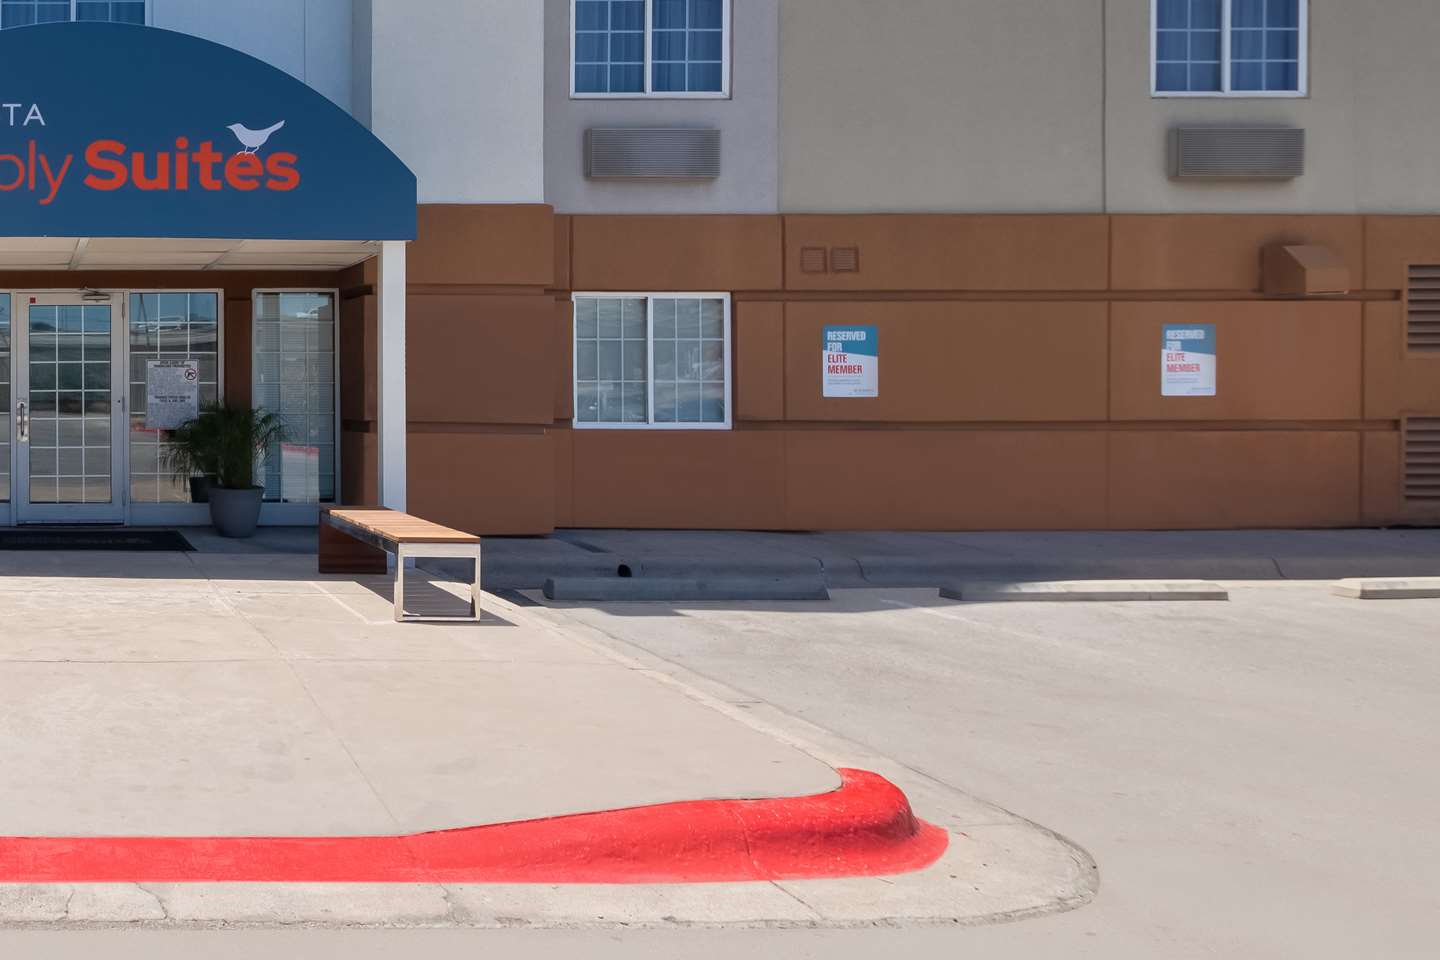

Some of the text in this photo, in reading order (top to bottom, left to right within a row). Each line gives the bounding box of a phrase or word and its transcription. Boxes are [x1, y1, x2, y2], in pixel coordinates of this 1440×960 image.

[83, 136, 301, 191] Suites
[827, 331, 866, 341] RESERVED
[827, 342, 843, 352] FOR
[827, 353, 848, 363] ELITE
[827, 364, 864, 374] MEMBER
